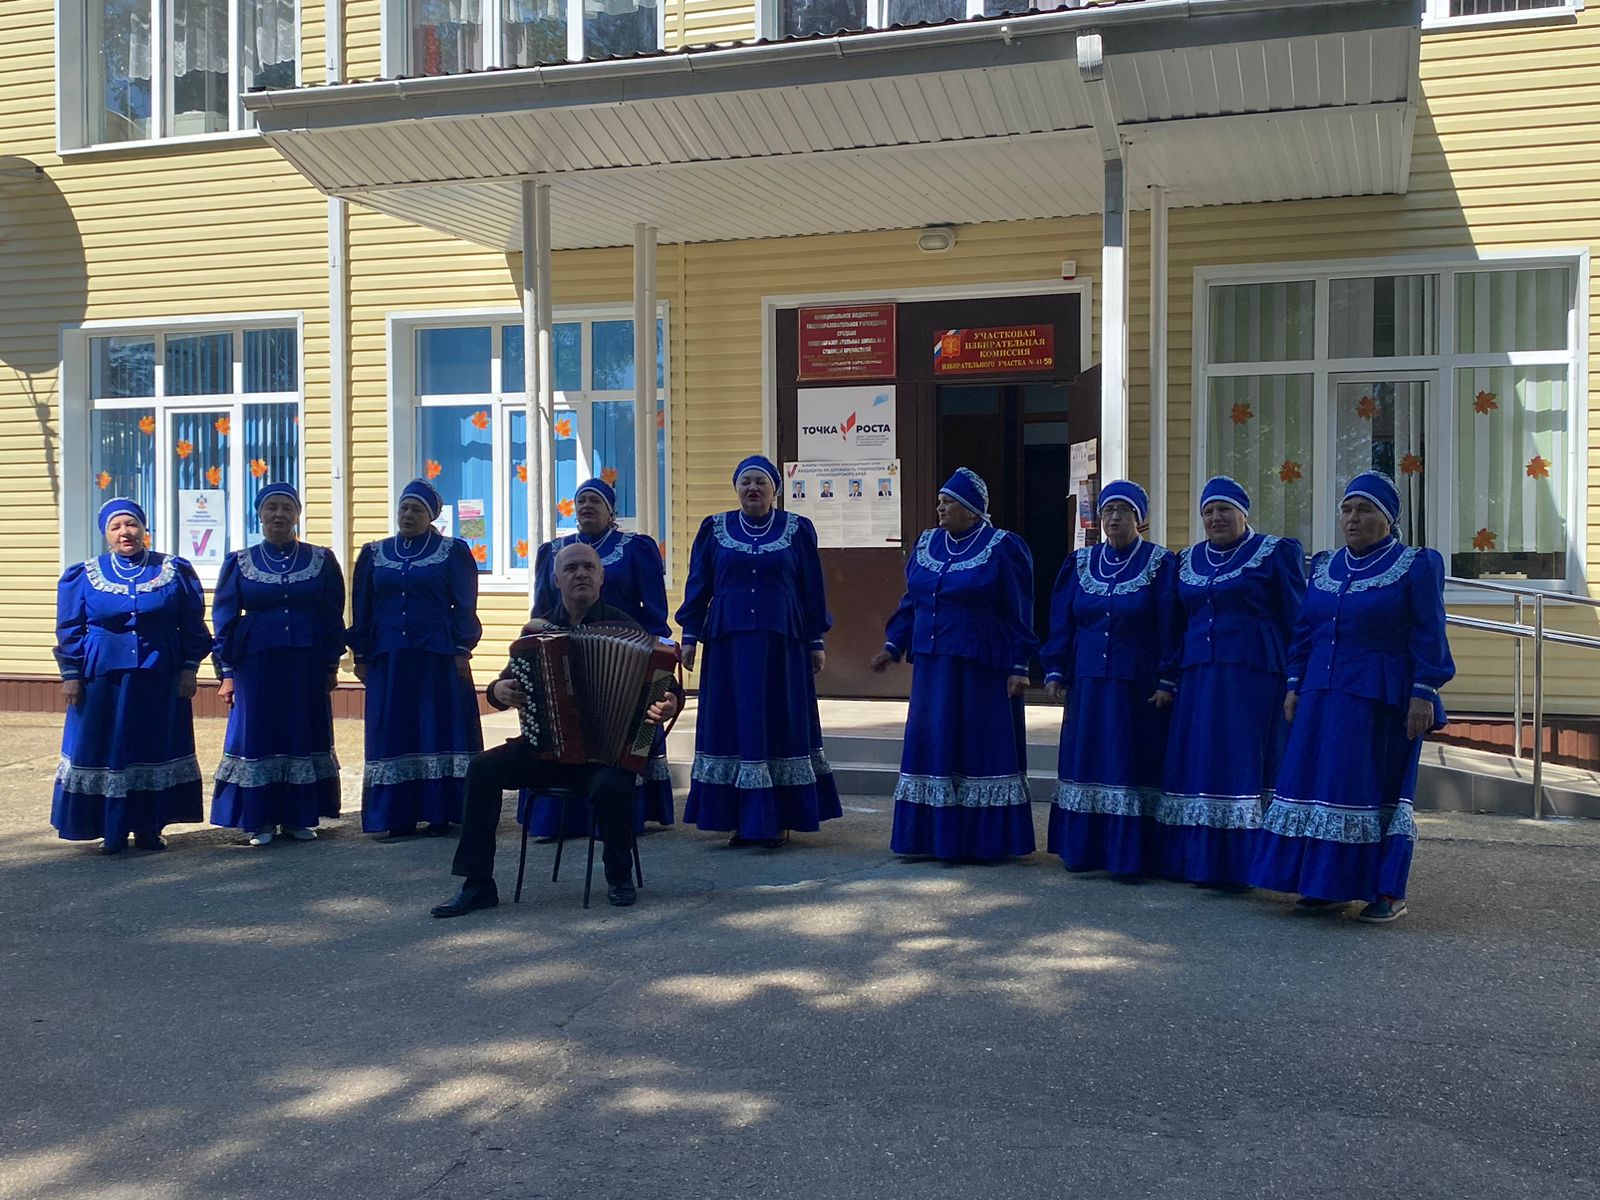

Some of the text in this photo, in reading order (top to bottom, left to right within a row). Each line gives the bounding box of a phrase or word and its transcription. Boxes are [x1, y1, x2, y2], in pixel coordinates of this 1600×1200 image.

[807, 321, 858, 329] ОБРАЗОВАТЕЛЬНОЕ
[973, 329, 1036, 340] УЧАСТКОВАЯ
[965, 338, 1046, 350] ИЗБИРАТЕЛЬНАЯ
[979, 348, 1031, 358] КОМИССИЯ
[941, 360, 995, 370] ИЗБИРАТЕЛЬНОГО
[998, 359, 1026, 367] УЧАСТКА
[802, 424, 891, 435] ТОЧКА РОСТА
